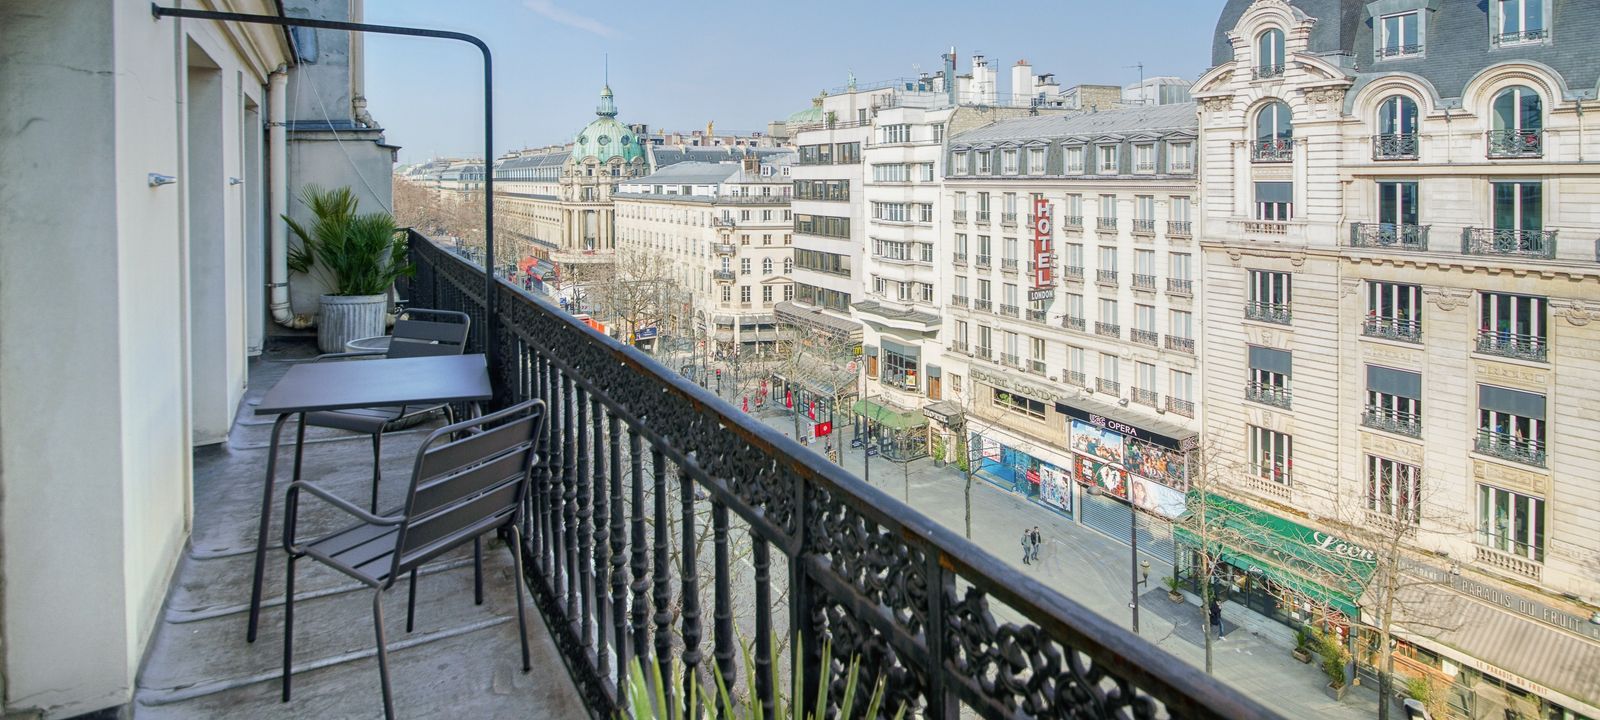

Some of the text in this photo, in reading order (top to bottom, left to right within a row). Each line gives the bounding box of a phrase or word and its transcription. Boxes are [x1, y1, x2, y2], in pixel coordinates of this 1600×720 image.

[1037, 202, 1051, 286] HOTEL
[1031, 290, 1053, 300] LONDON
[1108, 420, 1137, 437] OPERA
[1462, 580, 1512, 608] PARADIS
[1519, 600, 1535, 616] DU
[1543, 608, 1580, 632] FRUIT
[1528, 683, 1548, 696] FRUIT
